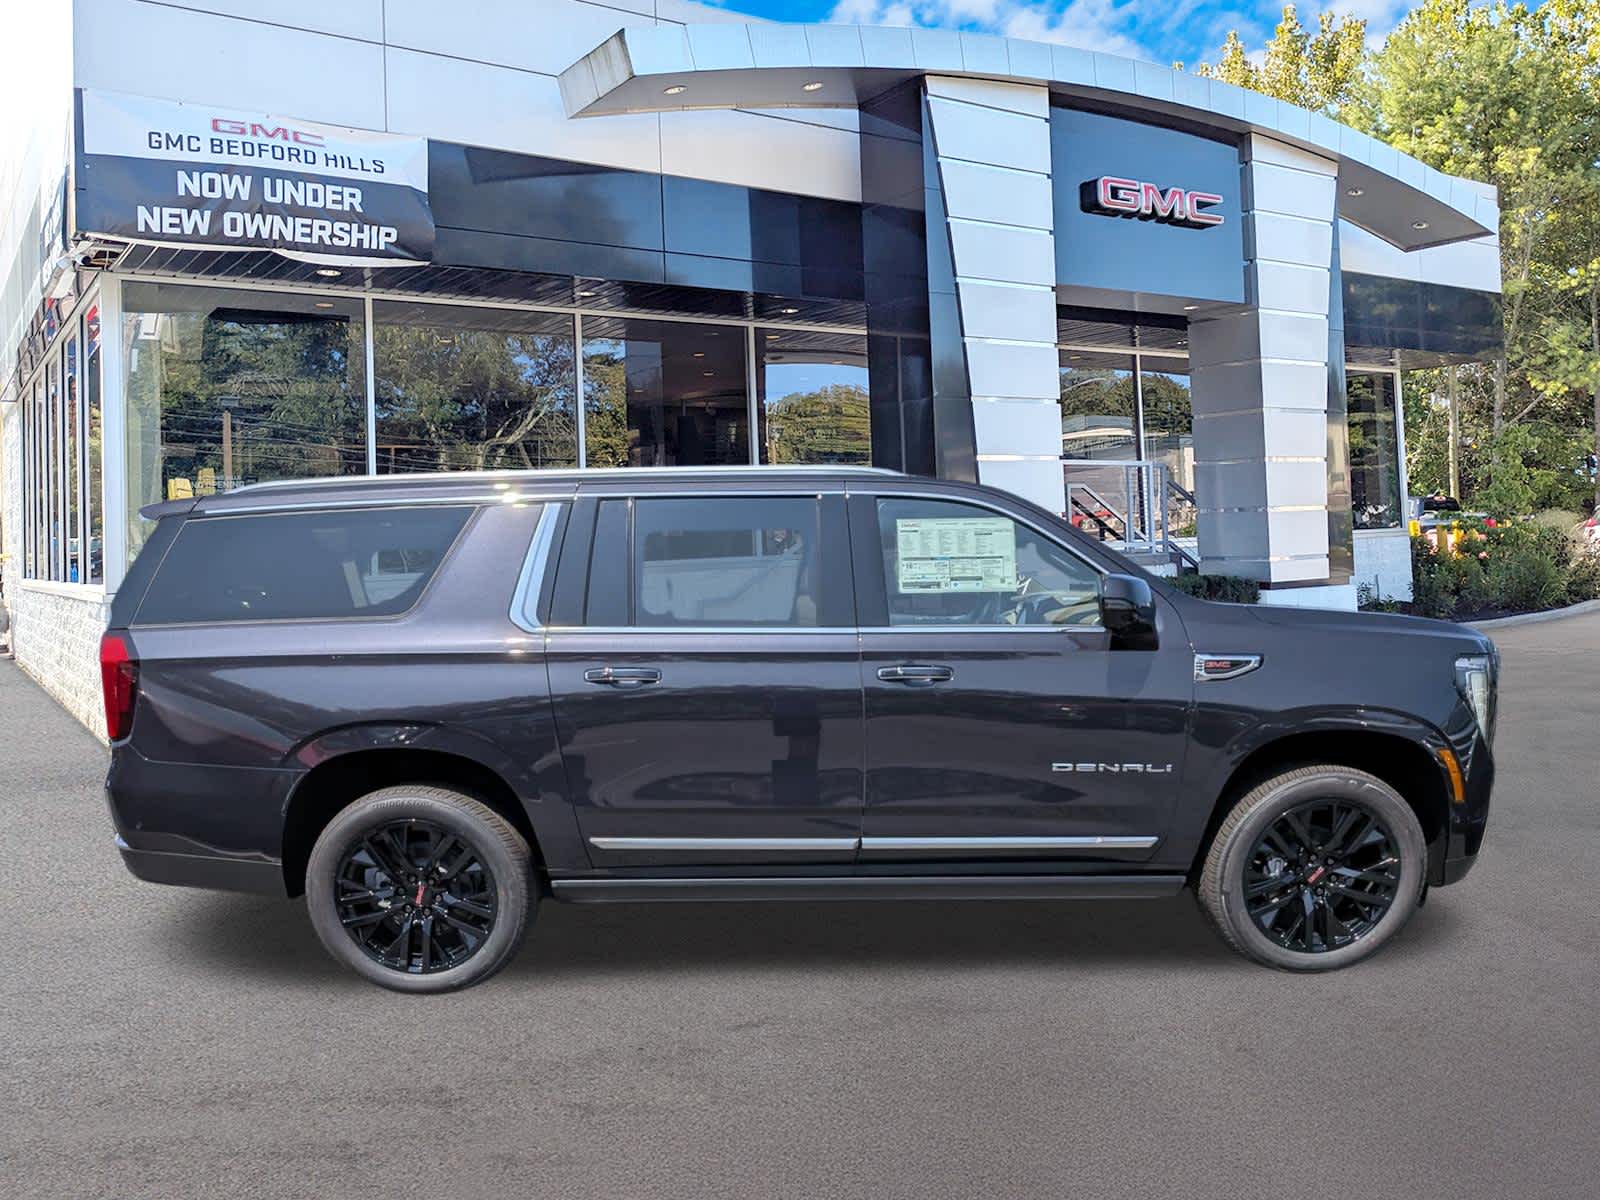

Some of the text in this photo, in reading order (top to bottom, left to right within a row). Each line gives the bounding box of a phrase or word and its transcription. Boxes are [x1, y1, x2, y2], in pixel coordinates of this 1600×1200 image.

[148, 131, 385, 174] GMC BEDFORD HILLS
[211, 118, 326, 148] GMC
[177, 170, 364, 213] NOW UNDER
[1097, 175, 1225, 225] GMC
[137, 205, 398, 250] NEW OWNERSHIP
[1051, 763, 1173, 773] DENALI
